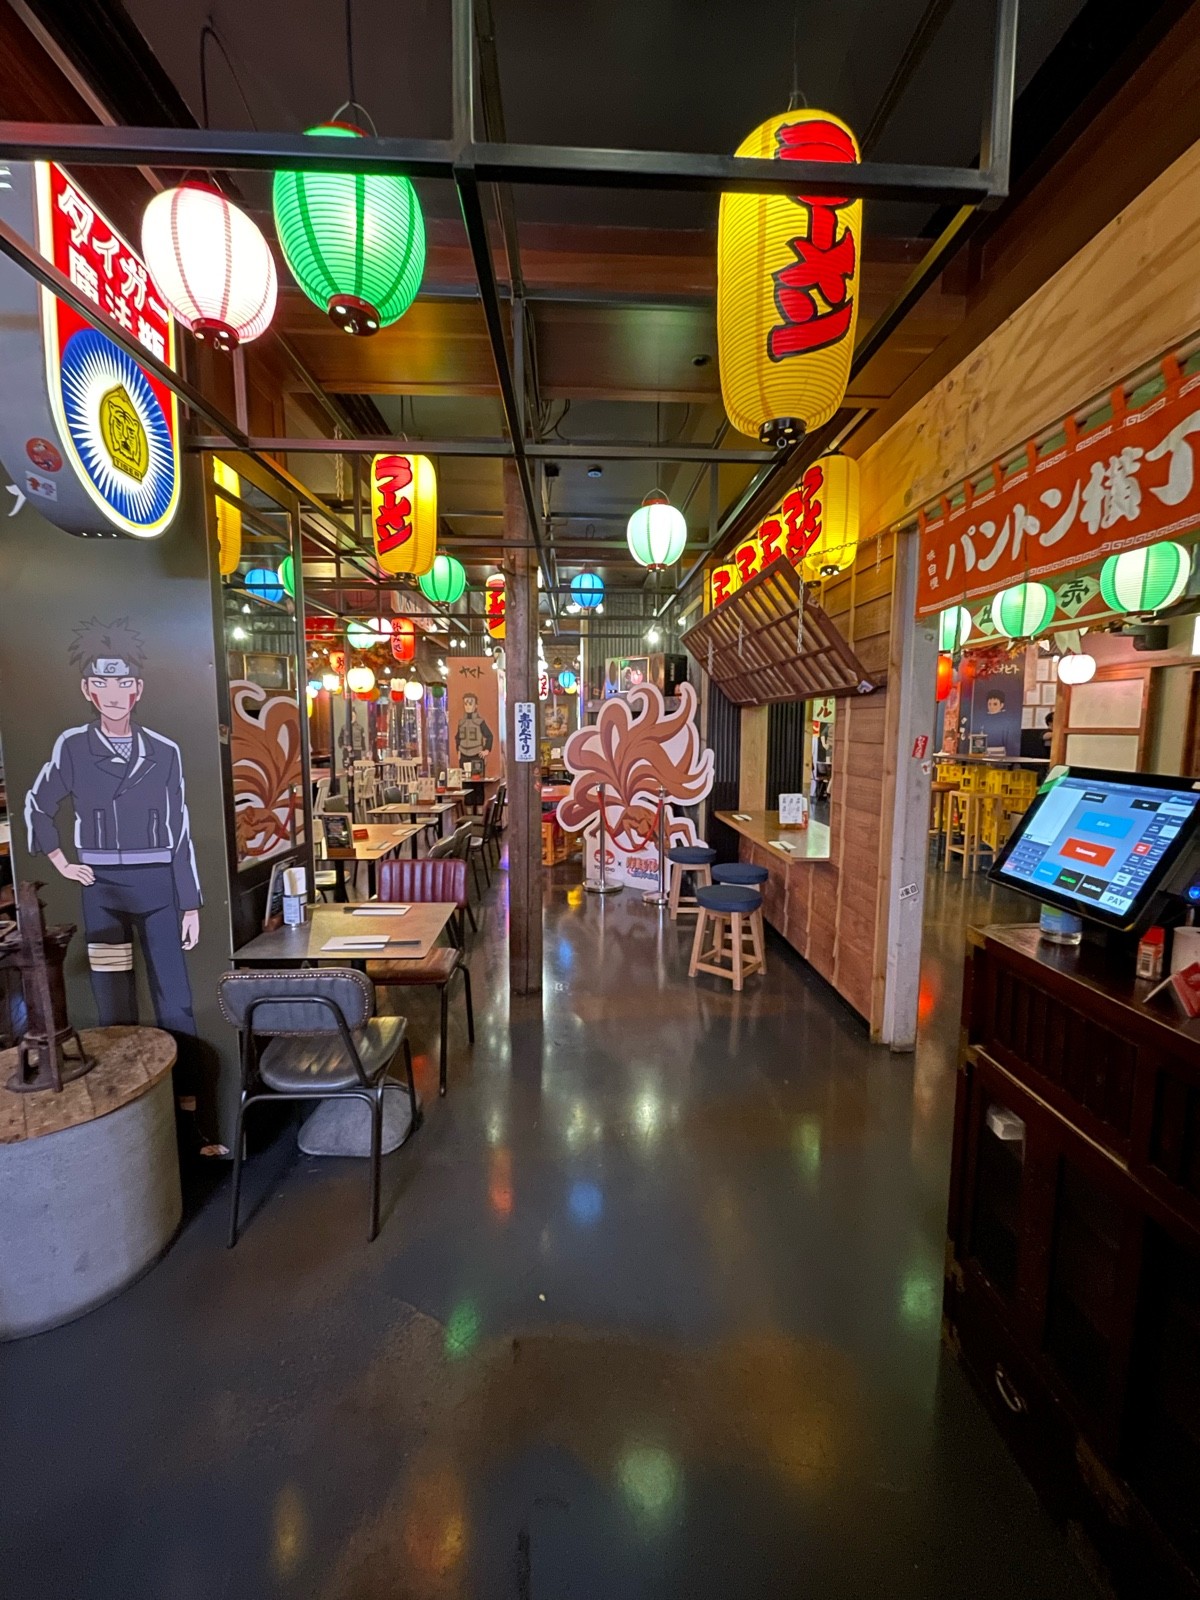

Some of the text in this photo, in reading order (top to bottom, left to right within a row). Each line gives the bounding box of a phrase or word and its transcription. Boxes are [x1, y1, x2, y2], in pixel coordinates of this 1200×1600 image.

[58, 184, 169, 325] タイガー
[115, 459, 141, 478] TIGER
[375, 455, 413, 555] ラーメン
[1107, 896, 1126, 906] PAY
